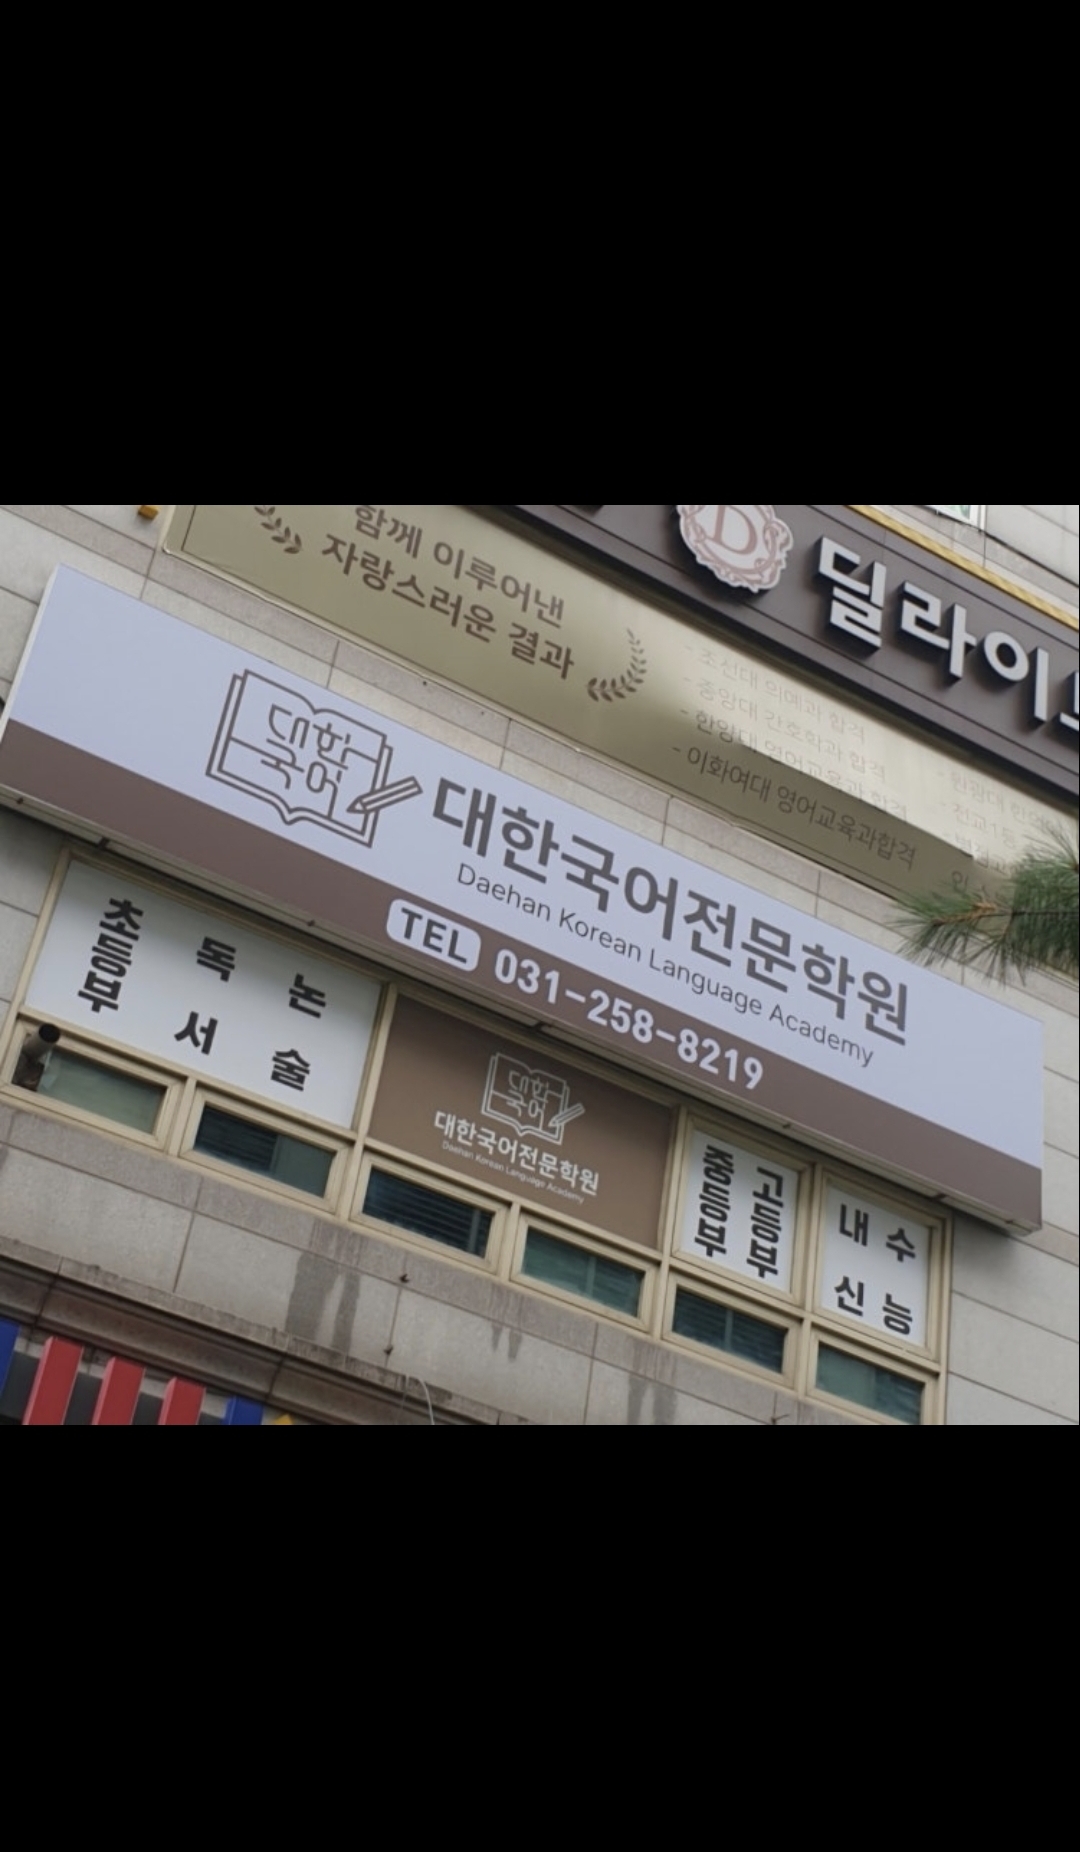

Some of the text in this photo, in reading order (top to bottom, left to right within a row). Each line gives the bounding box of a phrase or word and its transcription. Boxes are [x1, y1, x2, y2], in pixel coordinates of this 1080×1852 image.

[321, 533, 575, 681] 자랑스러운 결과
[355, 505, 565, 629] 함께 이루어낸
[268, 703, 349, 770] 대한
[696, 678, 758, 722] 중앙대
[260, 737, 343, 818] 국어
[687, 746, 916, 871] 이화여대 영어교육과합격
[78, 897, 144, 1014] 초등부
[432, 777, 909, 1046] 대한국어전문학원
[456, 863, 875, 1068] Daehan Korean Language Academy
[400, 907, 764, 1091] TEL 031-258-8219
[508, 1069, 549, 1103] 대한
[434, 1110, 599, 1196] 대한국어전문학원
[441, 1140, 585, 1205] Daehan Korean Language Academy
[695, 1144, 735, 1257] 중등부
[746, 1166, 784, 1278] 고등부
